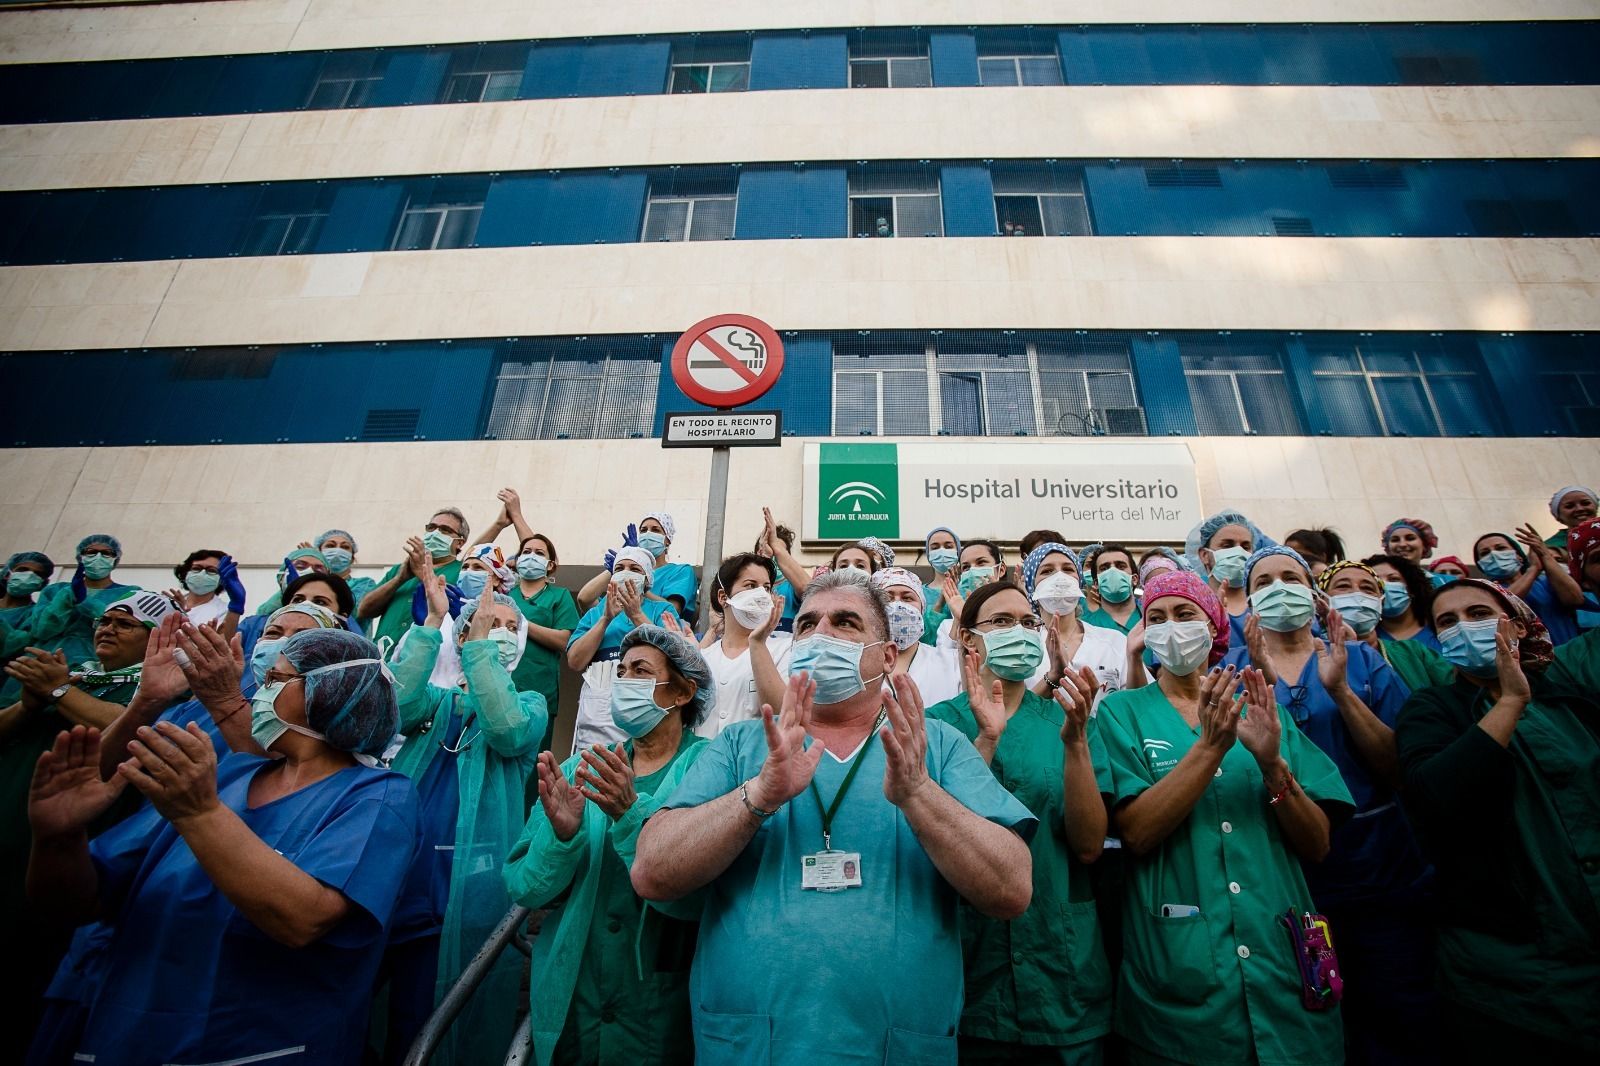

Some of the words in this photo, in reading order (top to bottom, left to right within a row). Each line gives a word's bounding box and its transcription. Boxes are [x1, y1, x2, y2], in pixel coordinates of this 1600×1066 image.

[689, 419, 714, 427] TODO
[731, 418, 773, 426] RECINTO
[687, 428, 756, 437] HOSPITALARIO
[924, 478, 1020, 503] Hospital
[1031, 478, 1179, 499] Universitario
[827, 513, 846, 521] JUNTA
[848, 513, 856, 521] DE
[1061, 506, 1114, 521] Puerta
[1121, 506, 1144, 521] del
[1151, 506, 1182, 521] Mar
